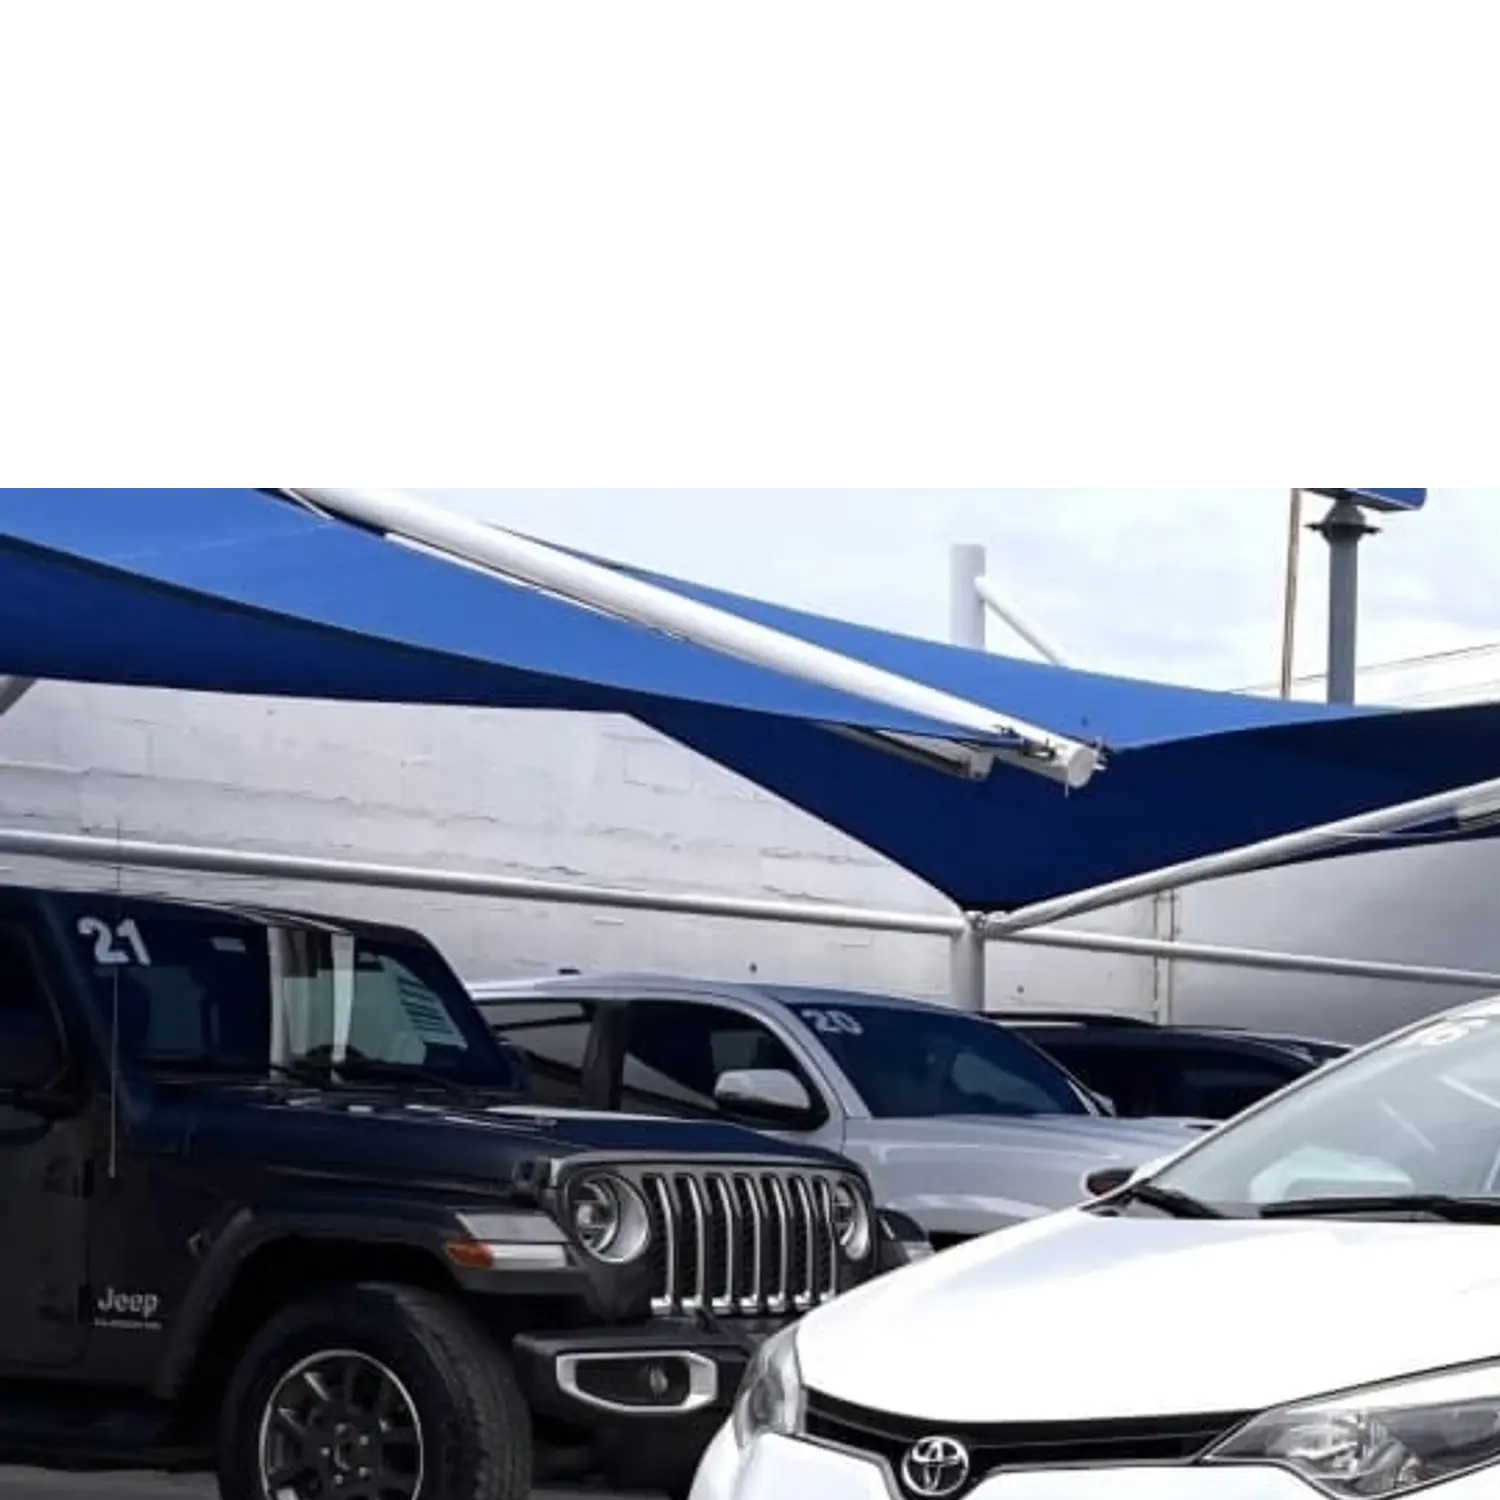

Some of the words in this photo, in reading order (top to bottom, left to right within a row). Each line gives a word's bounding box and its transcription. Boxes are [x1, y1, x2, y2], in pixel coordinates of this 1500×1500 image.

[77, 916, 152, 967] 21
[801, 1008, 864, 1035] 20
[97, 1287, 158, 1318] Jeep
